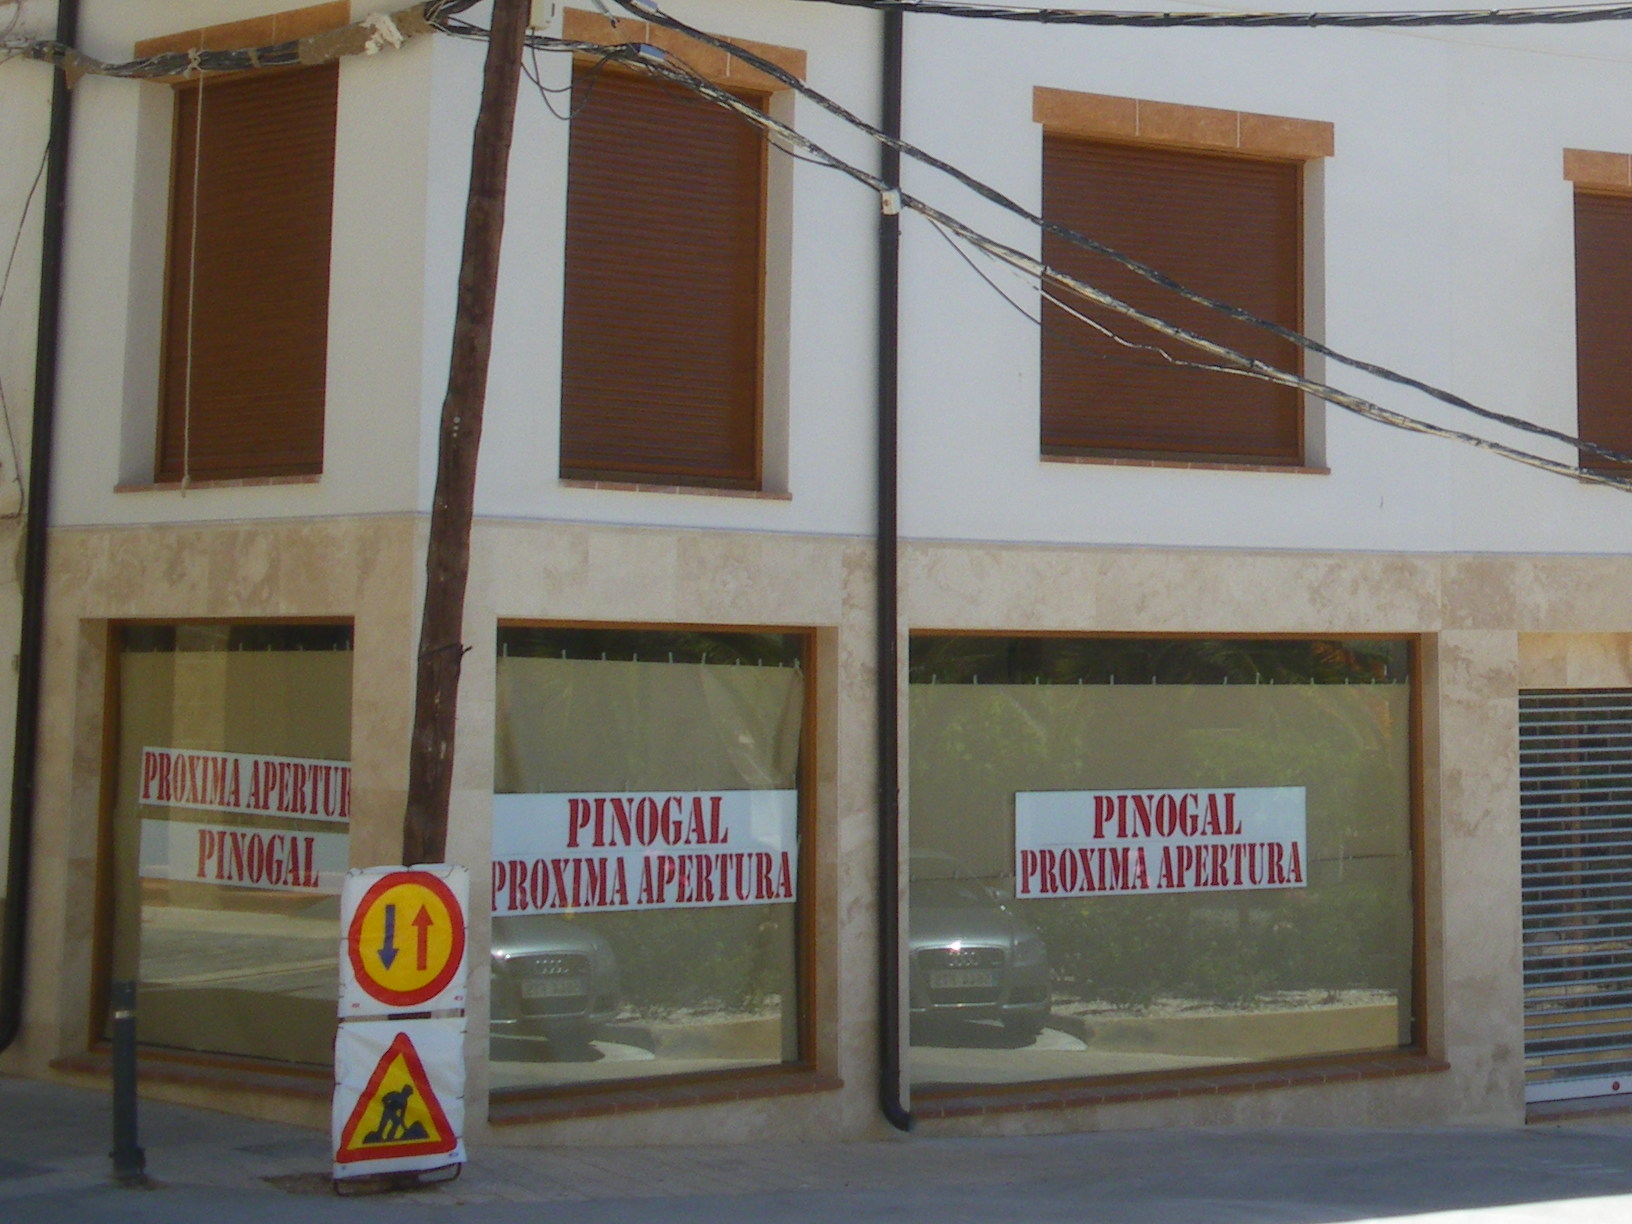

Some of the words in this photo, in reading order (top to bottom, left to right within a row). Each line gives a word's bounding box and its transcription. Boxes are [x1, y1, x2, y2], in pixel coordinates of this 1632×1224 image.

[143, 752, 241, 809] PROXIMA
[567, 796, 728, 848] PINOGAL
[1093, 793, 1242, 839] PINOGAL
[197, 829, 319, 888] PINOGAL
[491, 857, 629, 911] PROXIMA
[637, 851, 792, 905] APERTURA
[1021, 847, 1150, 894] PROXIMA
[1157, 841, 1303, 889] APERTURA
